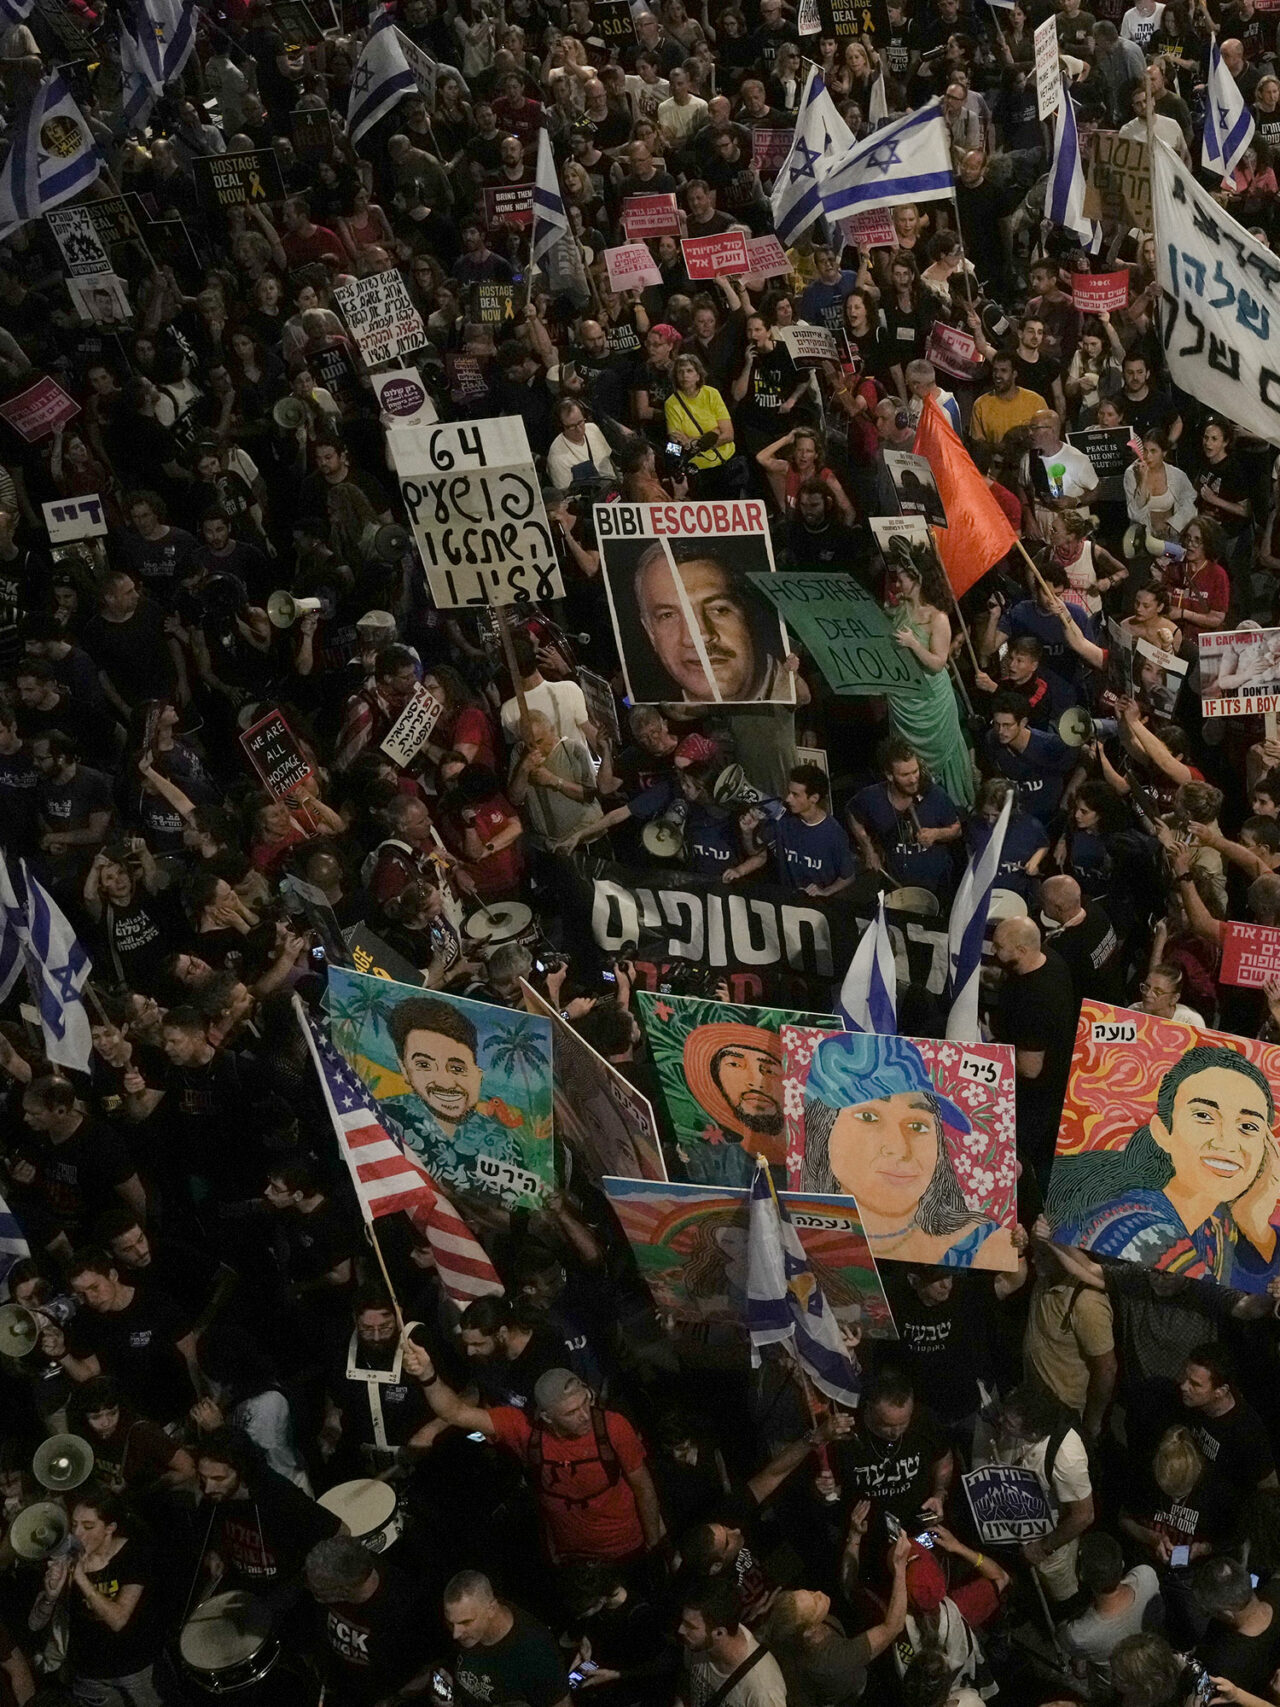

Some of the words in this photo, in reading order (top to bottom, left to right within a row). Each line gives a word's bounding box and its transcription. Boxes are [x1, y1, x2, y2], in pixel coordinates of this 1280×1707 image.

[832, 10, 857, 22] DEAL
[835, 22, 859, 36] NOW
[209, 156, 260, 174] HOSTAGE
[213, 173, 243, 189] DEAL
[217, 188, 246, 204] NOW
[495, 192, 516, 202] BRING
[495, 204, 515, 213] HOME
[721, 241, 742, 252] קול
[479, 285, 514, 296] HOSTAGE
[1107, 287, 1127, 298] נשים
[480, 298, 500, 309] DEAL
[481, 309, 501, 321] NOW
[430, 427, 487, 471] 64
[1086, 445, 1109, 453] PEACE
[1092, 459, 1124, 468] OLUTION
[402, 473, 535, 525] פושעים
[599, 506, 645, 536] BIBI
[649, 503, 764, 535] ESCOBAR
[425, 521, 554, 566] השתלטו
[445, 563, 557, 605] עלינו
[759, 579, 869, 602] HOSTAGE
[815, 617, 884, 639] DEAL
[1202, 637, 1212, 647] IN
[1220, 688, 1239, 698] YOU
[1243, 686, 1269, 697] DON'T
[1205, 701, 1216, 716] IF
[1220, 699, 1241, 715] IT'S
[1245, 698, 1253, 713] A
[1257, 696, 1278, 712] BOY
[251, 735, 265, 752] WE
[266, 721, 285, 741] ARE
[266, 744, 286, 763] ALL
[268, 754, 301, 786] HOSTAGE
[273, 762, 311, 797] FAMILIES
[592, 878, 834, 976] חטופים
[1232, 925, 1256, 940] את
[1094, 1024, 1136, 1041] נועה
[962, 1059, 998, 1083] לירי
[480, 1160, 537, 1193] הירש
[796, 1215, 851, 1231] נעמה
[967, 1467, 1037, 1487] בחירות
[987, 1521, 1047, 1539] עכשיו!
